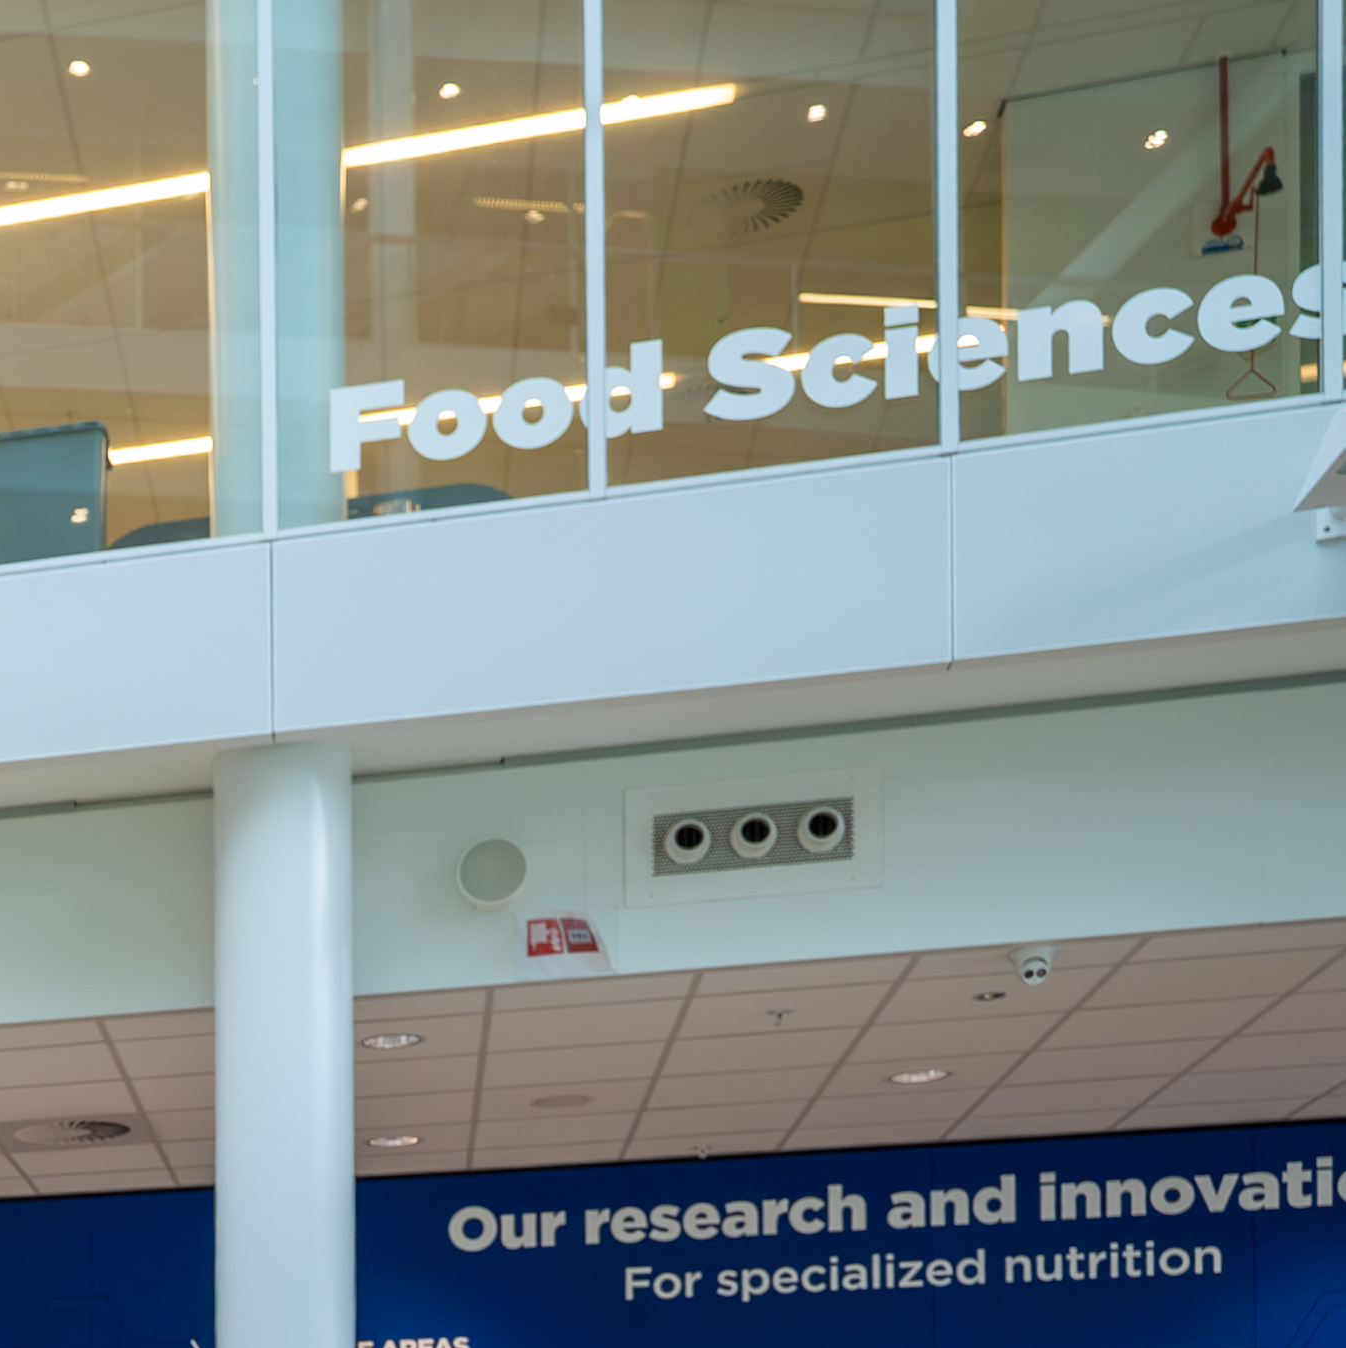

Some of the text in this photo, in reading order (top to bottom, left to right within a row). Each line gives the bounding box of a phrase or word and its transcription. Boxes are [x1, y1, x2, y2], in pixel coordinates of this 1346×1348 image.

[329, 262, 1346, 474] Food Sciences
[447, 1155, 1346, 1253] Our research and innovati
[624, 1239, 1223, 1303] For specialized nutrition
